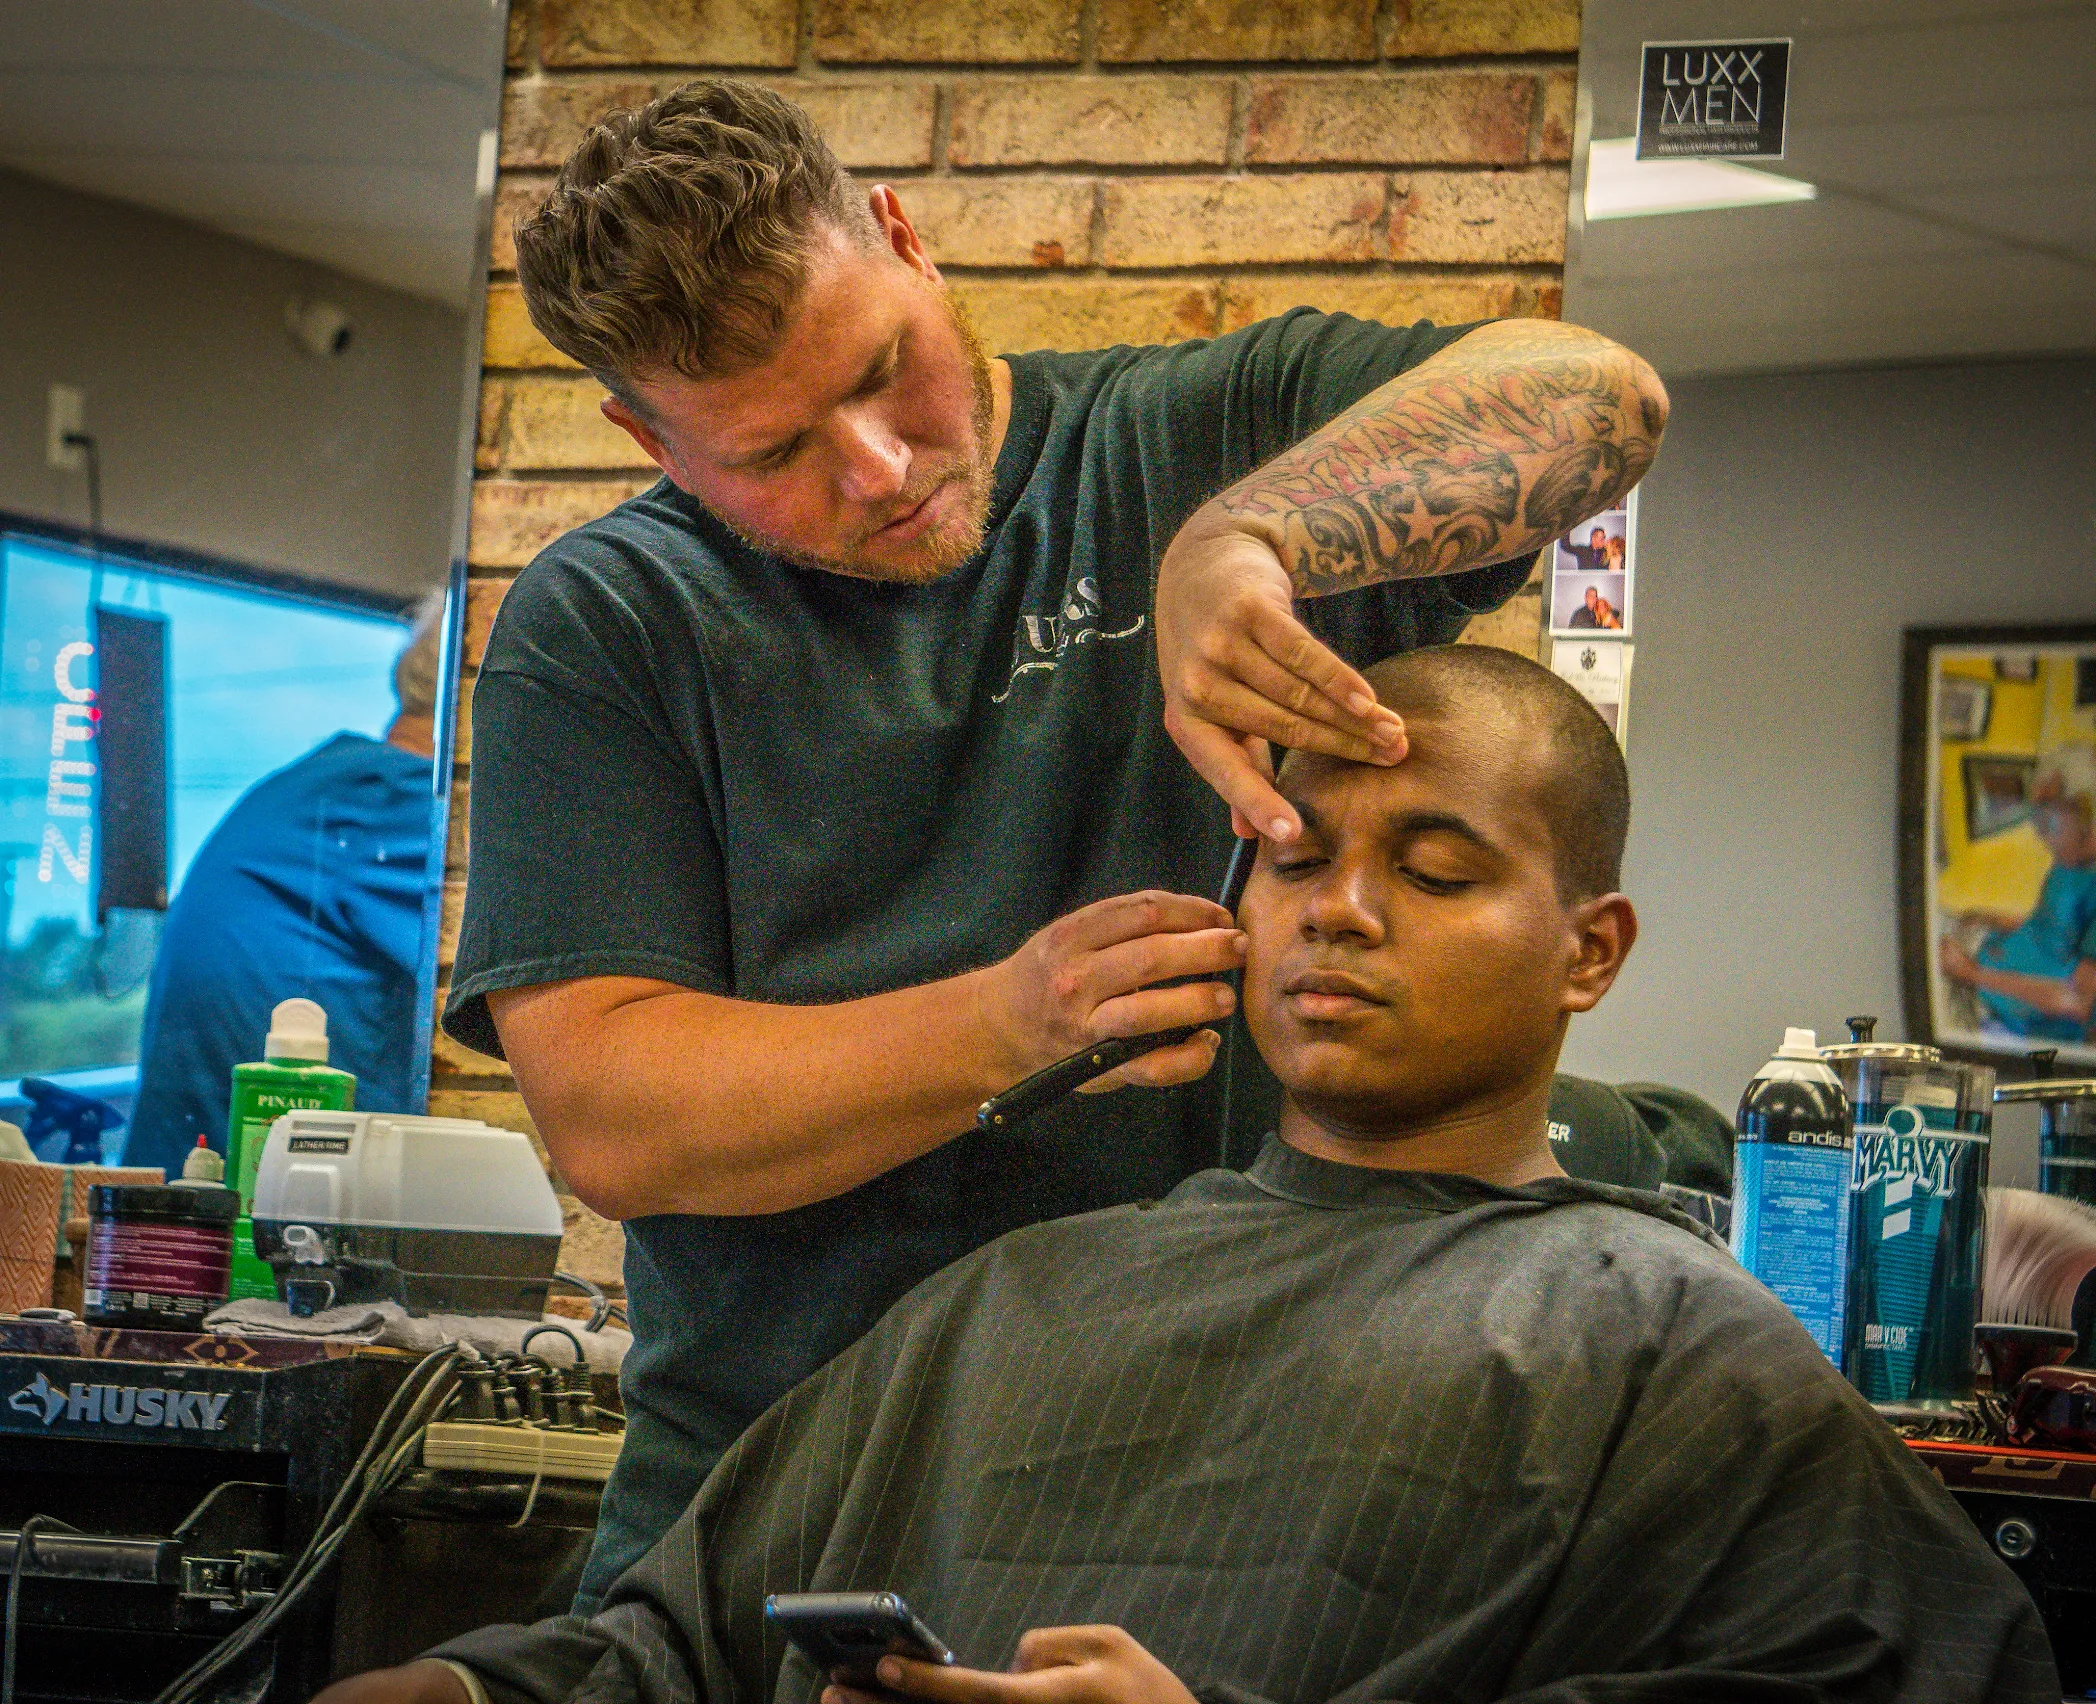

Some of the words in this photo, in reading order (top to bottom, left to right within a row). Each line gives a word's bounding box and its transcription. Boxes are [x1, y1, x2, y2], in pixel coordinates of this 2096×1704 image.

[1663, 50, 1763, 86] LUXX
[1660, 84, 1762, 125] MEN
[257, 1094, 322, 1110] PINAUD
[1545, 1119, 1571, 1142] ER
[1788, 1129, 1843, 1147] andis
[1850, 1132, 1970, 1198] MARVY
[66, 1382, 232, 1430] HUSKY
